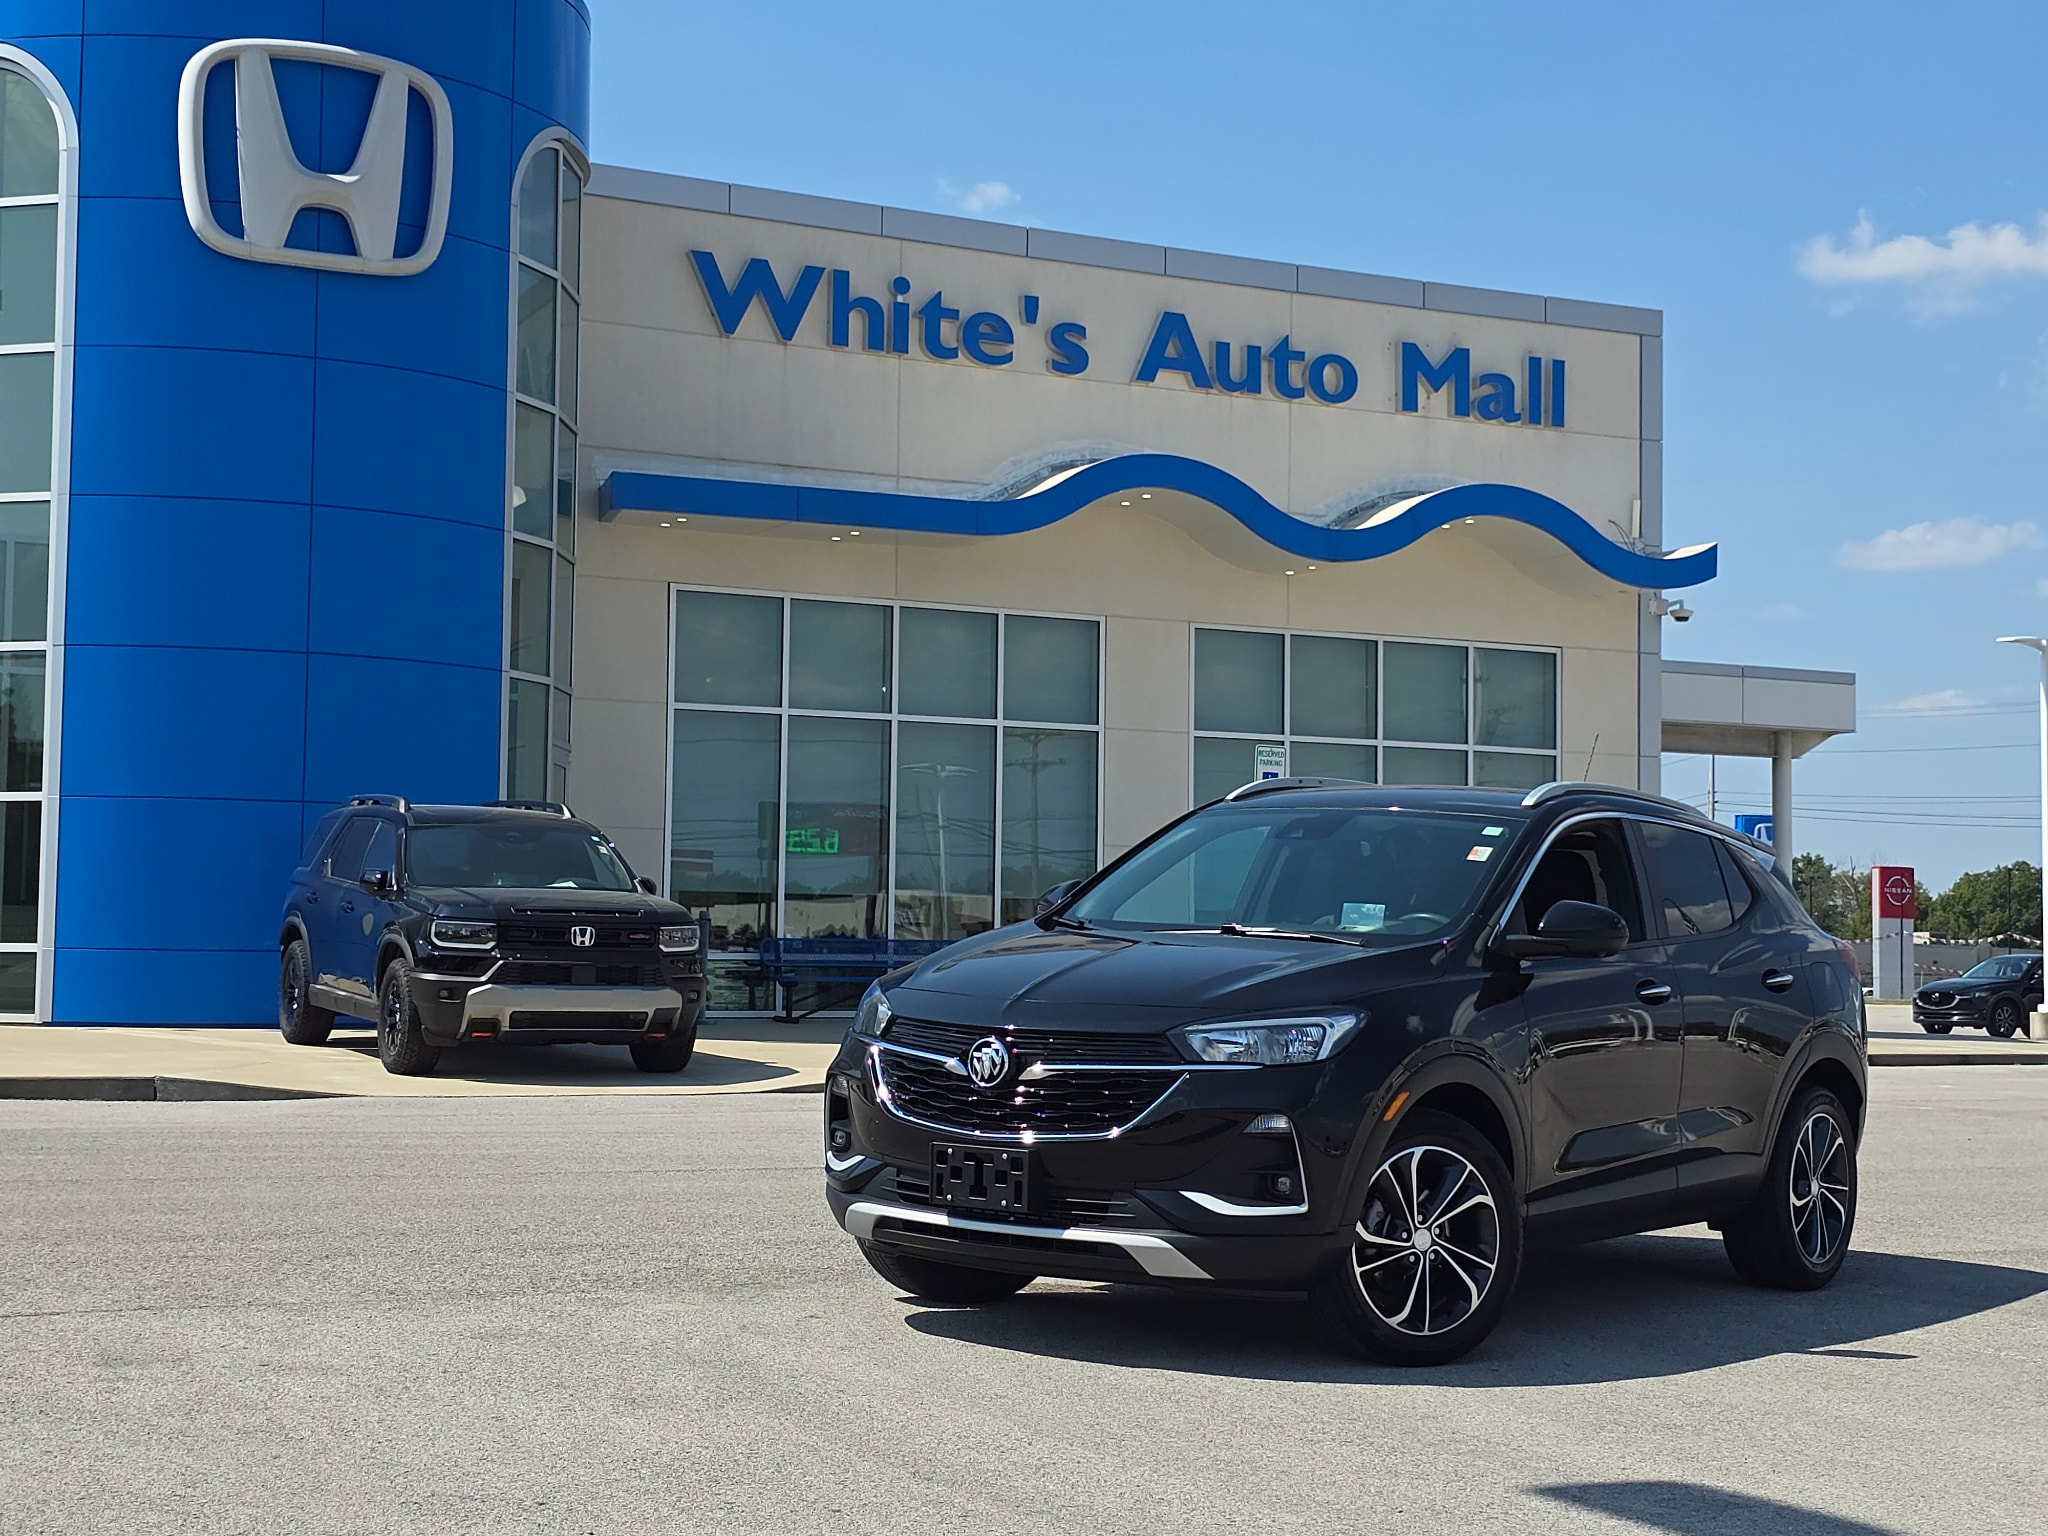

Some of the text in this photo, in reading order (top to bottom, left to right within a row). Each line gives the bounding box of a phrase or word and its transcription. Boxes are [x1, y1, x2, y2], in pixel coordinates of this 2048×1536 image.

[689, 249, 1567, 428] White's Auto Mall
[1258, 750, 1284, 758] RESERVED
